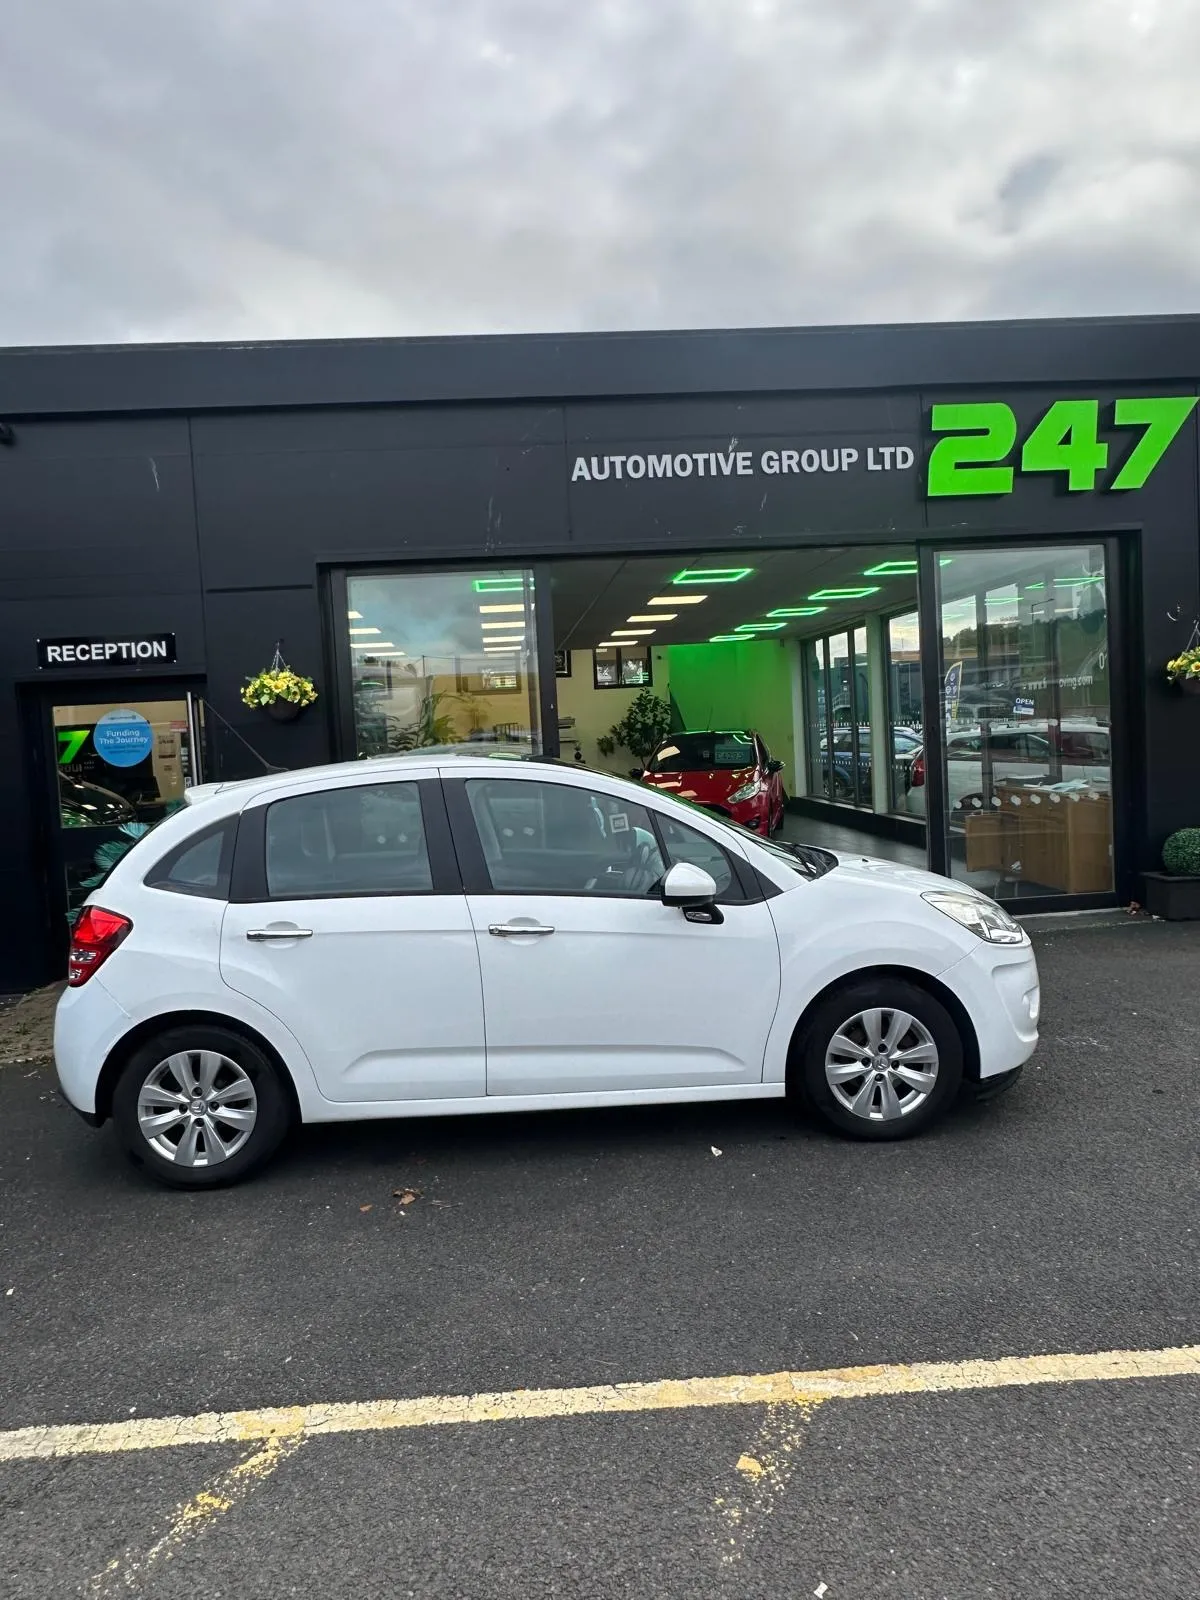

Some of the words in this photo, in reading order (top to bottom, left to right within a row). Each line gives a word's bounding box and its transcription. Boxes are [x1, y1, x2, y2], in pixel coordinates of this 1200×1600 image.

[927, 396, 1199, 497] 247
[571, 449, 754, 482] AUTOMOTIVE
[760, 447, 859, 475] GROUP
[866, 445, 915, 472] LTD
[47, 640, 167, 662] RECEPTION
[1015, 697, 1035, 706] OPEN
[99, 737, 115, 745] The
[116, 736, 149, 745] Journey
[106, 729, 140, 739] Funding
